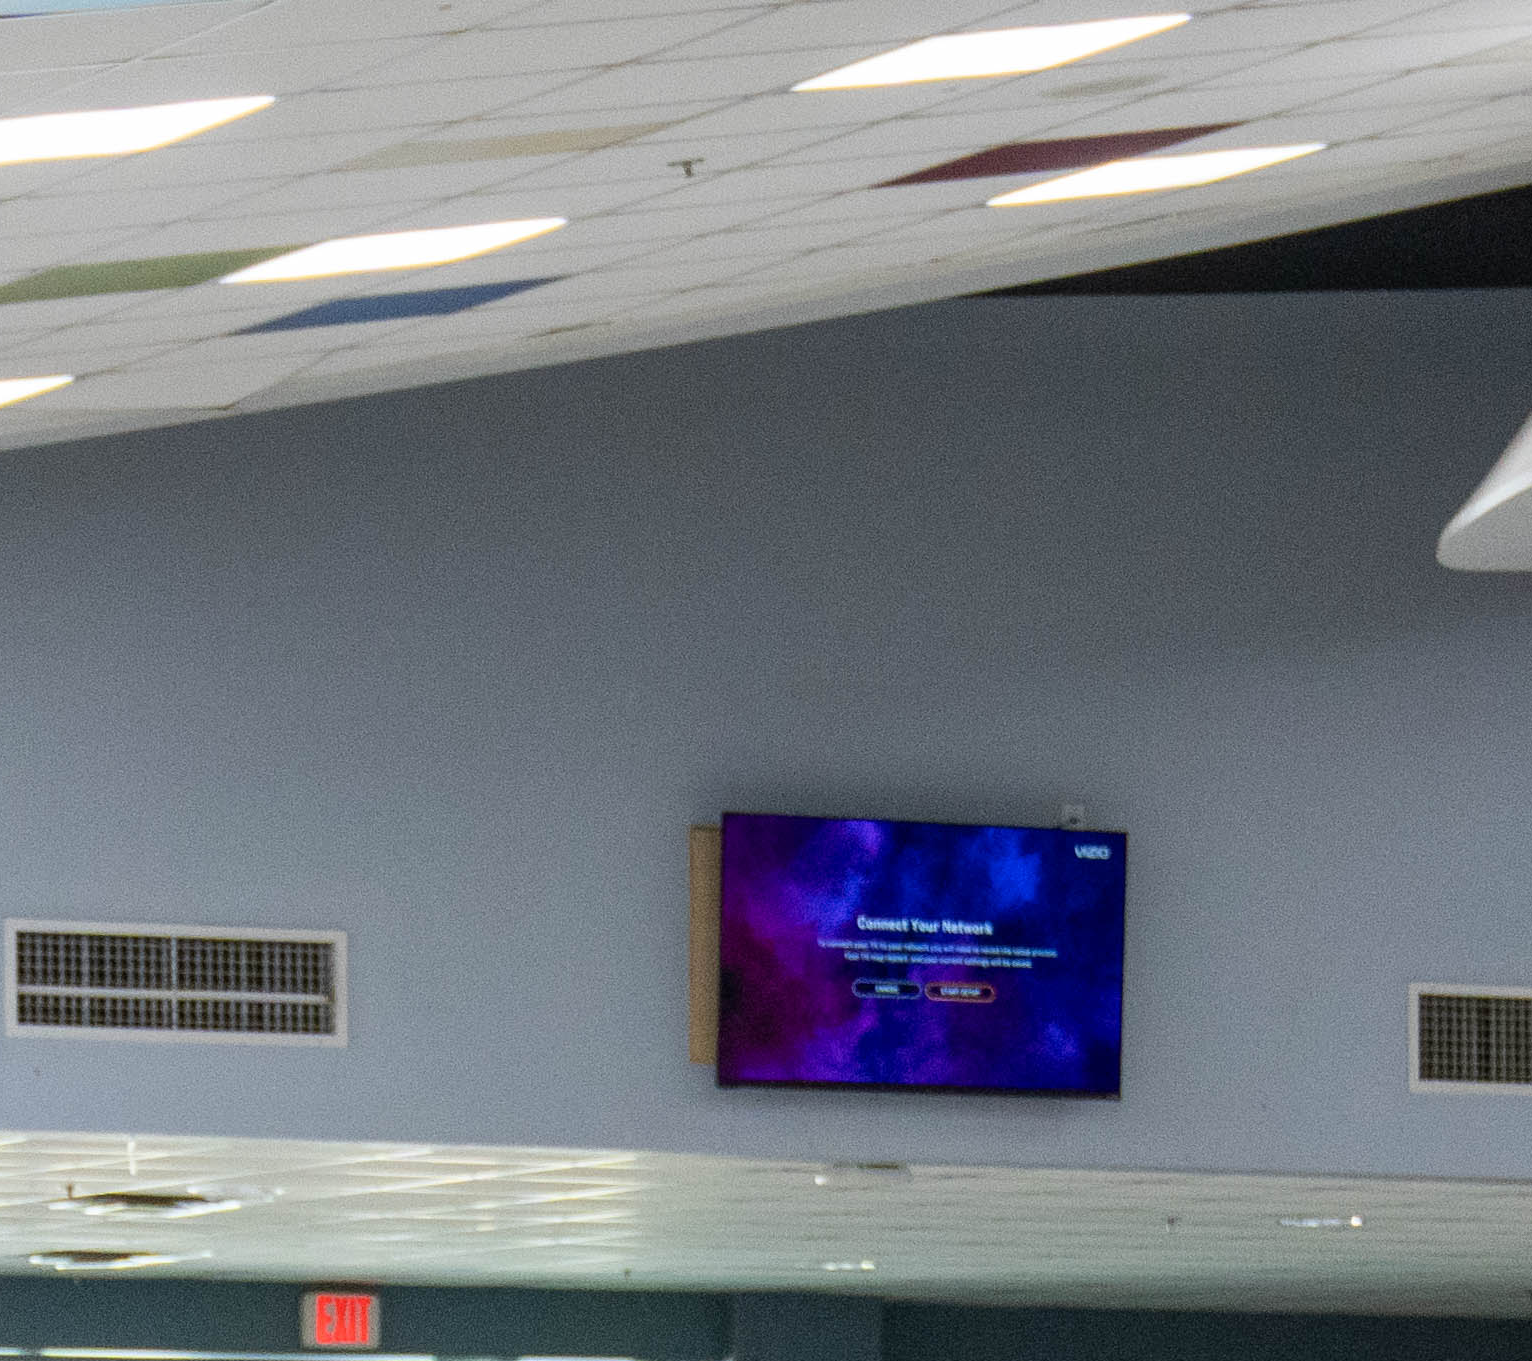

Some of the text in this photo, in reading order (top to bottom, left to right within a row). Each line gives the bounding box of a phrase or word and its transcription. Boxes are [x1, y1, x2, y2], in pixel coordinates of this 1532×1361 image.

[857, 915, 994, 935] Connect Your Network
[316, 1295, 372, 1344] EXIT
